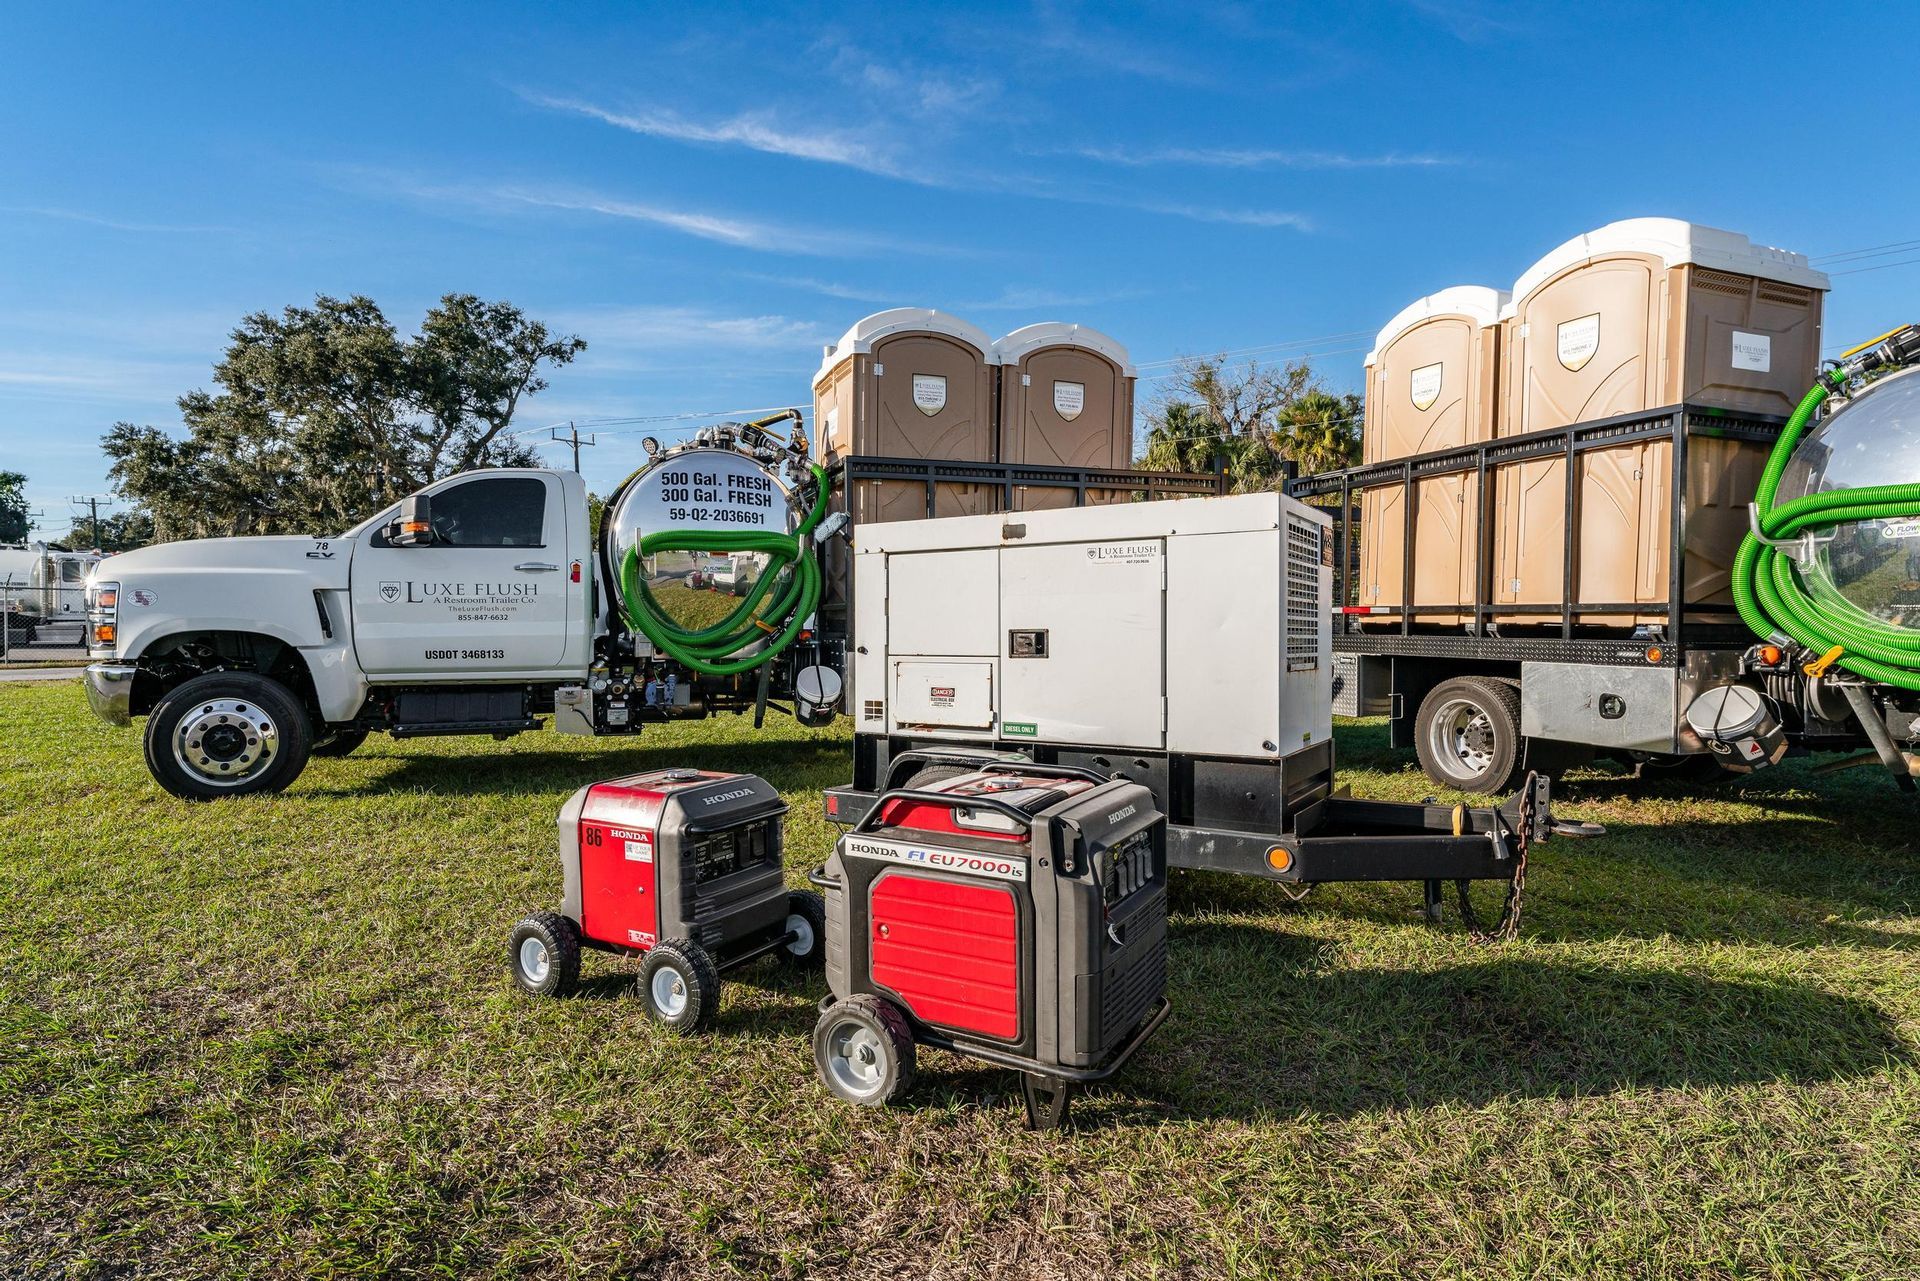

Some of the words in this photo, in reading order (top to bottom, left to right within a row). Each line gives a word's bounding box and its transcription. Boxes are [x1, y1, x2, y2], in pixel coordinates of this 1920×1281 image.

[661, 472, 688, 485] 500
[693, 472, 722, 486] Gal.
[727, 474, 771, 492] FRESH
[661, 488, 689, 502] 300
[694, 488, 722, 503] Gal.
[728, 490, 772, 507] FRESH
[670, 508, 764, 524] 59-Q2-2036691
[316, 542, 328, 550] 78
[1098, 547, 1123, 558] LUXE
[405, 581, 465, 604] LUXE
[475, 583, 538, 596] FLUSH
[433, 596, 443, 604] A
[443, 596, 487, 604] Restroom
[489, 596, 520, 604] Trailer
[521, 596, 537, 604] Co.
[425, 650, 459, 659] USDOT
[461, 649, 504, 659] 3468133
[932, 688, 954, 697] DANGER
[702, 788, 755, 805] HONDA
[1108, 804, 1136, 824] HONDA
[586, 827, 602, 847] 86
[610, 830, 649, 842] HONDA
[850, 843, 900, 858] HONDA
[907, 850, 926, 860] FI
[929, 853, 1023, 878] EU7000is
